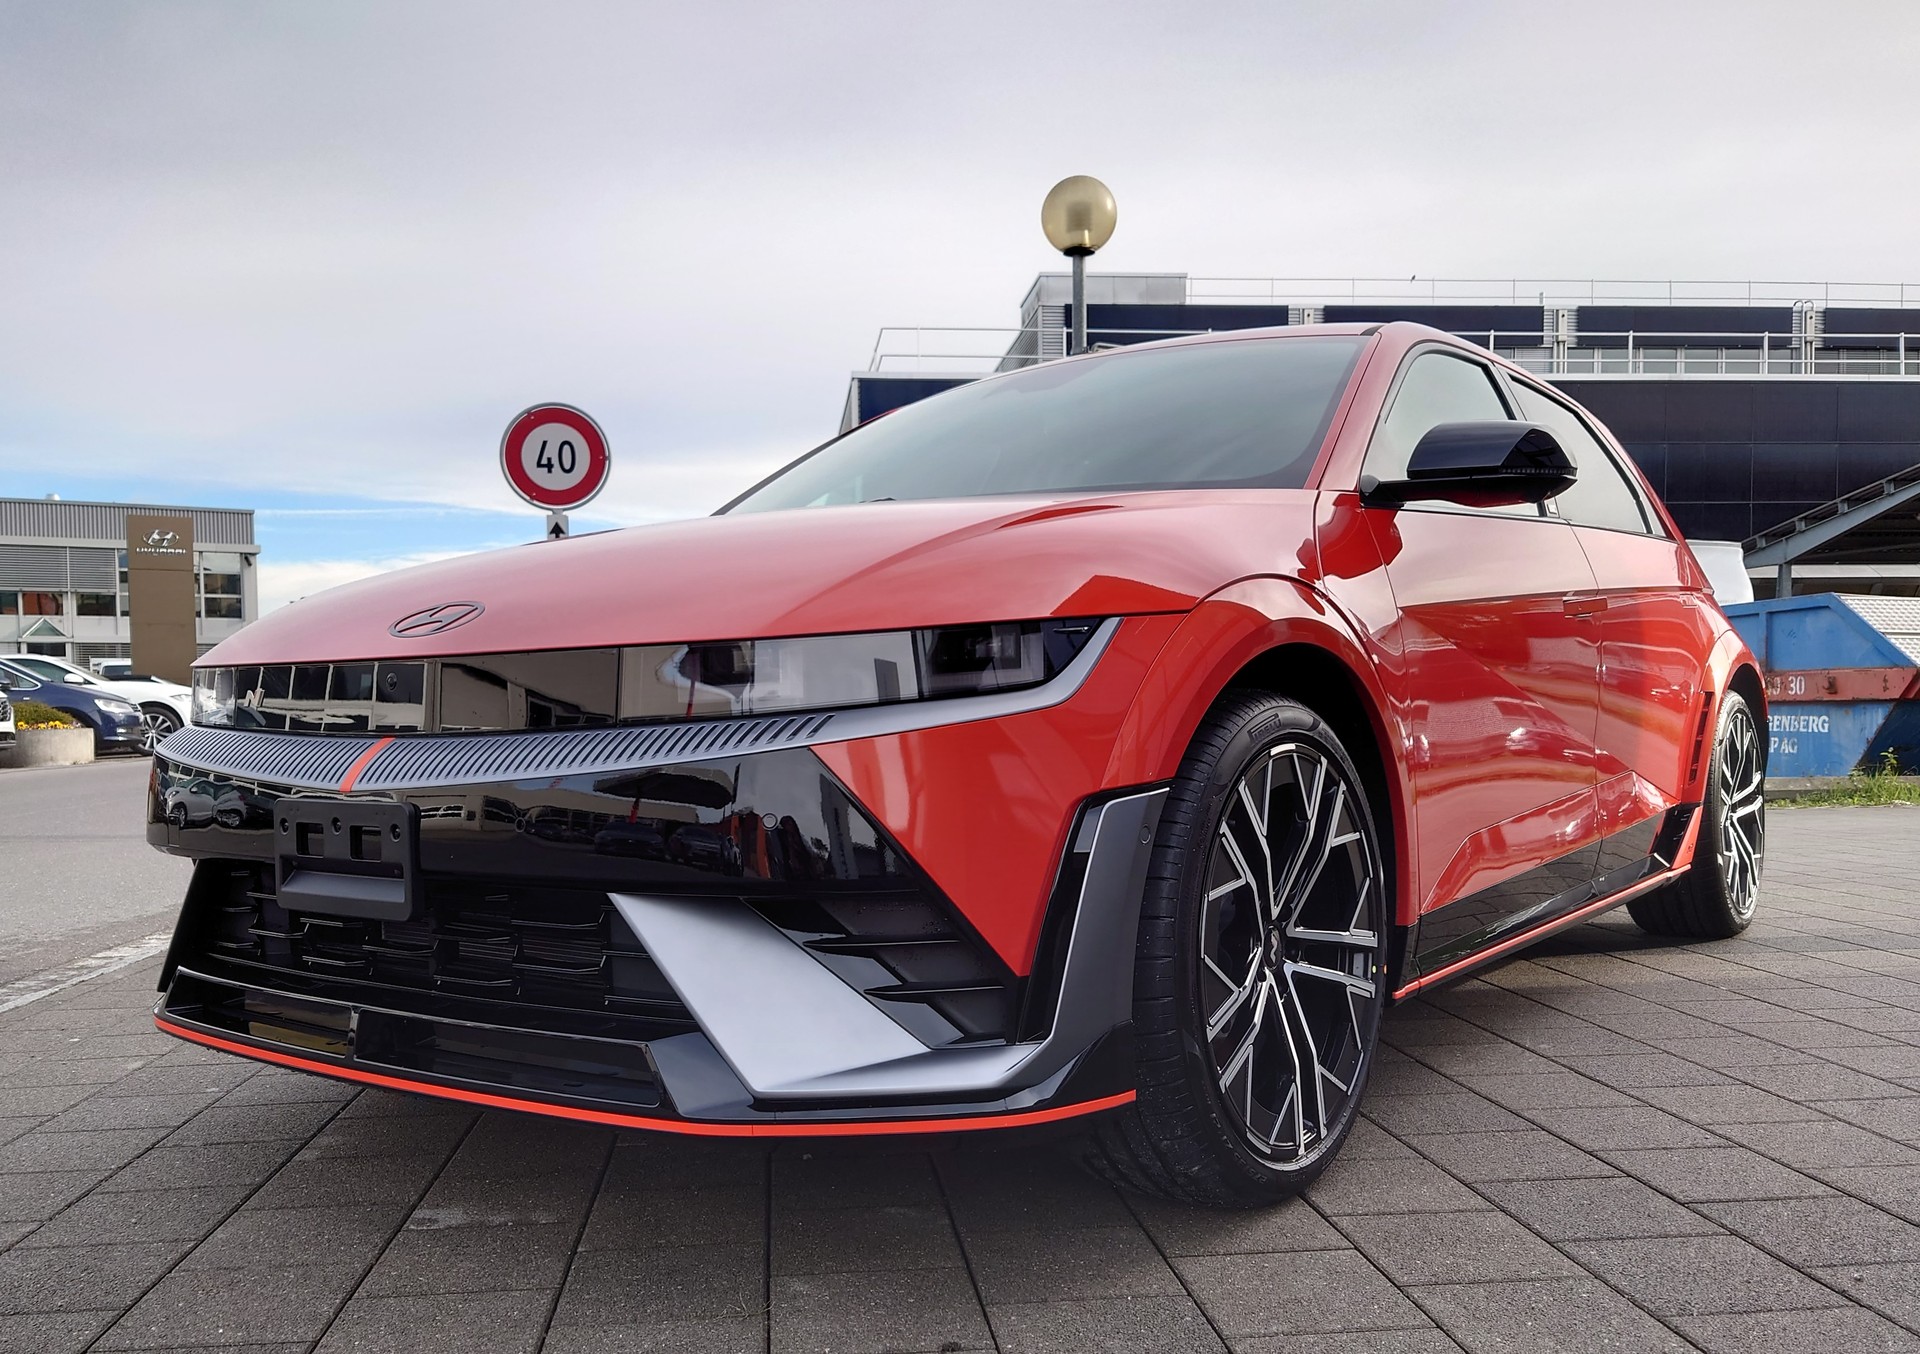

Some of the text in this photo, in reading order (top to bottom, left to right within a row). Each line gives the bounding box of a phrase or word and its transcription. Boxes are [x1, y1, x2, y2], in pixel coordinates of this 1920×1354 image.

[536, 440, 577, 474] 40
[1788, 675, 1805, 695] 30
[1780, 737, 1798, 754] AG
